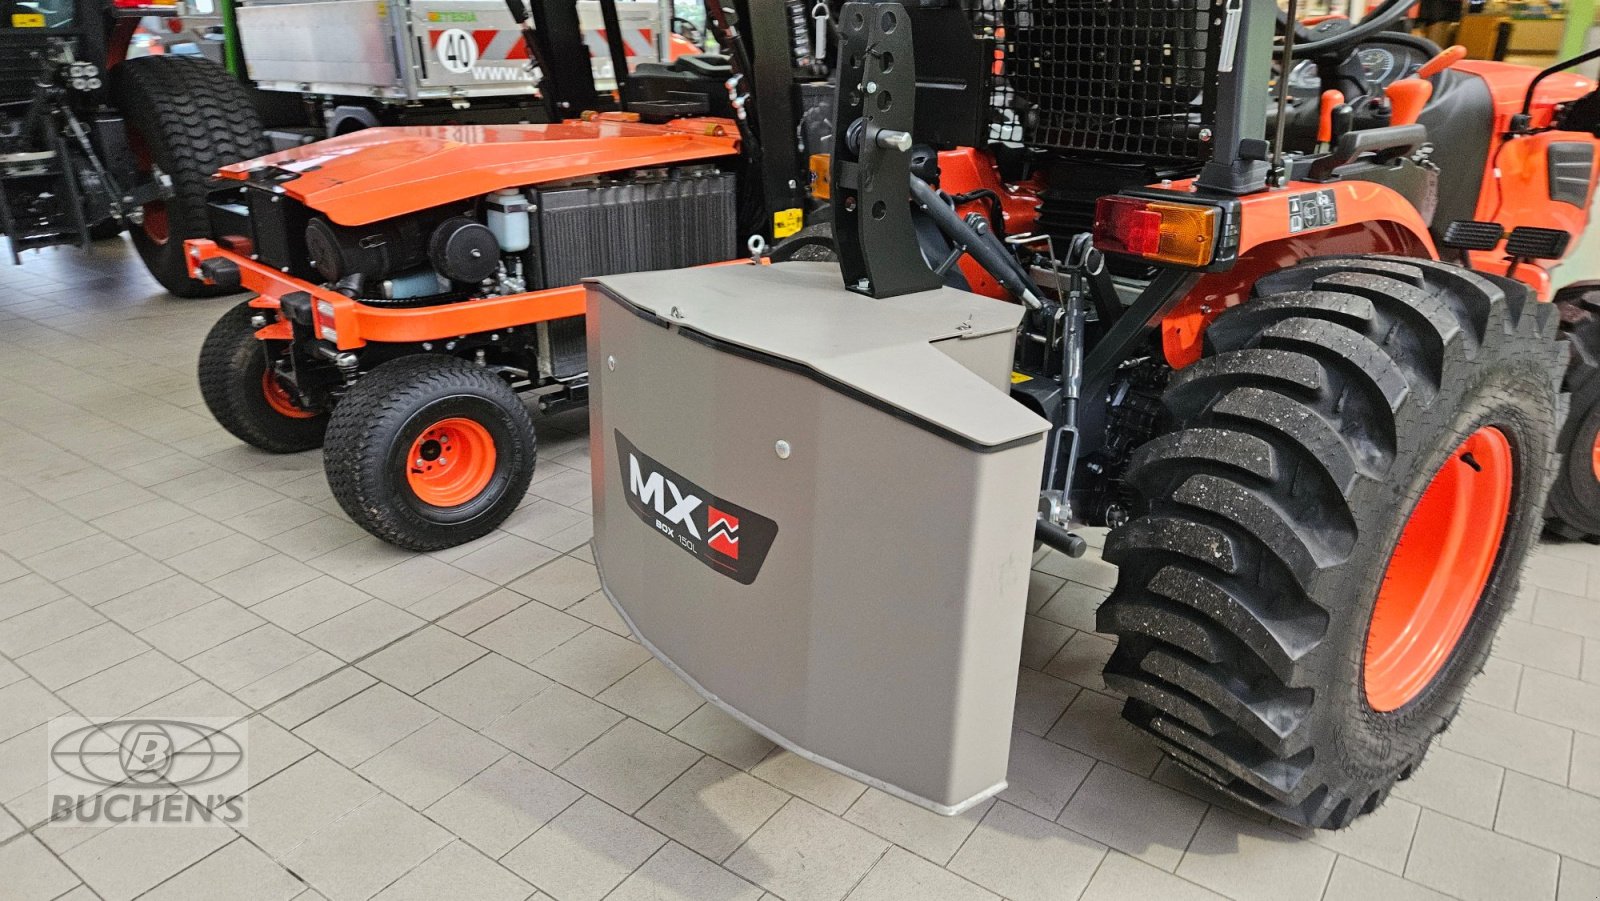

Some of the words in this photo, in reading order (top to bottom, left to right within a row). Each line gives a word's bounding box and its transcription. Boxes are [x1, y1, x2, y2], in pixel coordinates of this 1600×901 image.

[444, 34, 468, 67] 40
[629, 453, 703, 541] MX
[655, 519, 674, 538] BOX
[677, 534, 698, 555] 150L
